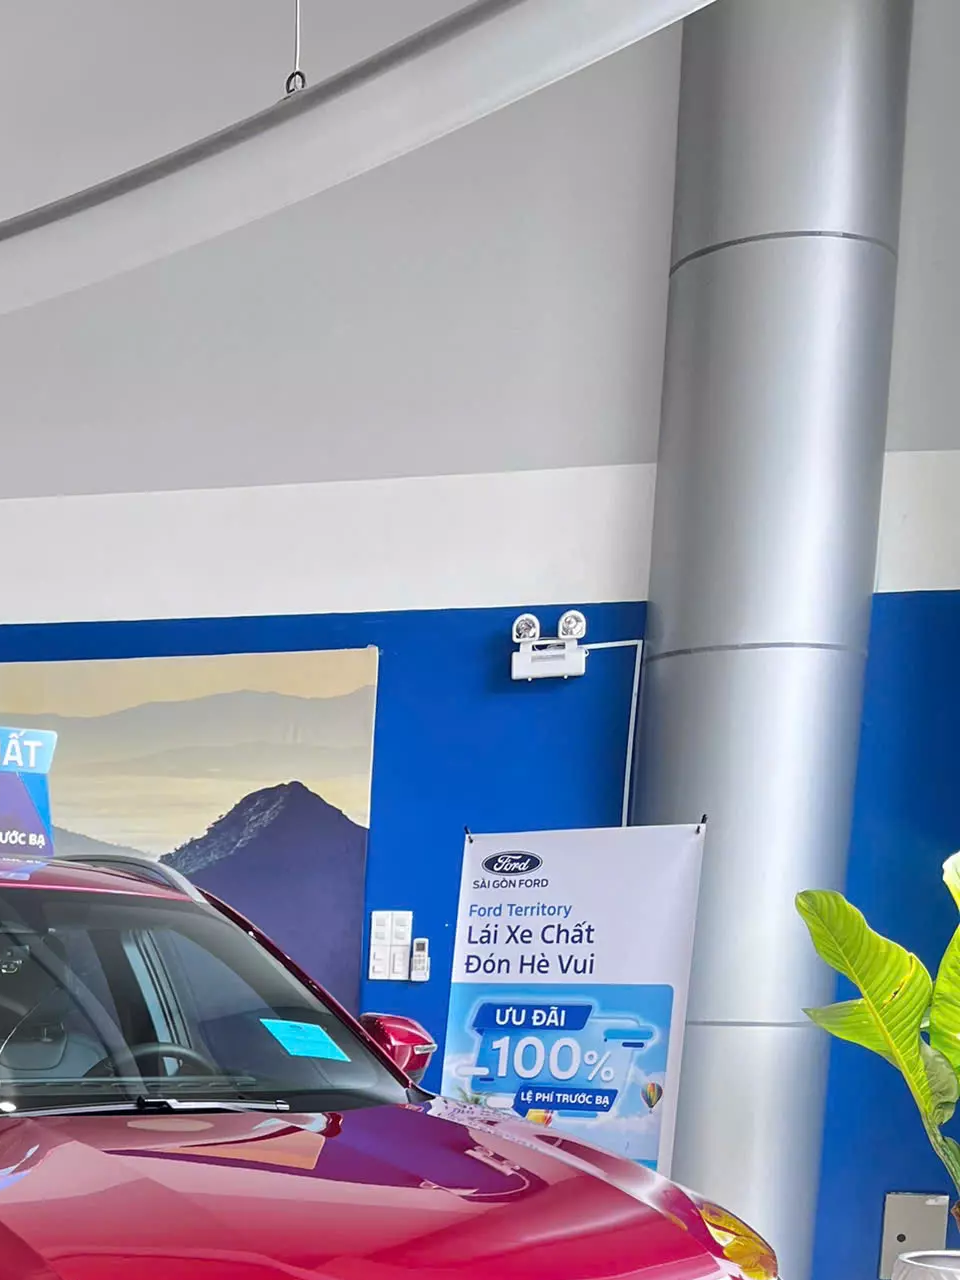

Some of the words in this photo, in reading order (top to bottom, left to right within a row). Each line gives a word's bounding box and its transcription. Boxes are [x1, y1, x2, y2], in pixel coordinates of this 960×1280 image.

[28, 833, 46, 849] BẠ
[493, 855, 530, 872] Ford
[472, 878, 490, 890] SÀI
[492, 877, 517, 889] GÒN
[518, 878, 549, 888] FORD
[469, 904, 503, 917] Ford
[507, 902, 573, 919] Territory
[467, 923, 499, 945] Lái
[505, 924, 533, 945] Xe
[541, 920, 595, 945] Chất
[464, 953, 510, 974] Đón
[519, 952, 550, 974] Hè
[558, 953, 595, 974] Vui
[495, 1006, 526, 1026] ƯU
[531, 1007, 566, 1027] ĐÃI
[491, 1035, 615, 1082] 100%
[521, 1089, 533, 1104] LỆ
[535, 1091, 554, 1103] PHÍ
[555, 1091, 593, 1105] TRƯỚC
[594, 1097, 610, 1107] BẠ
